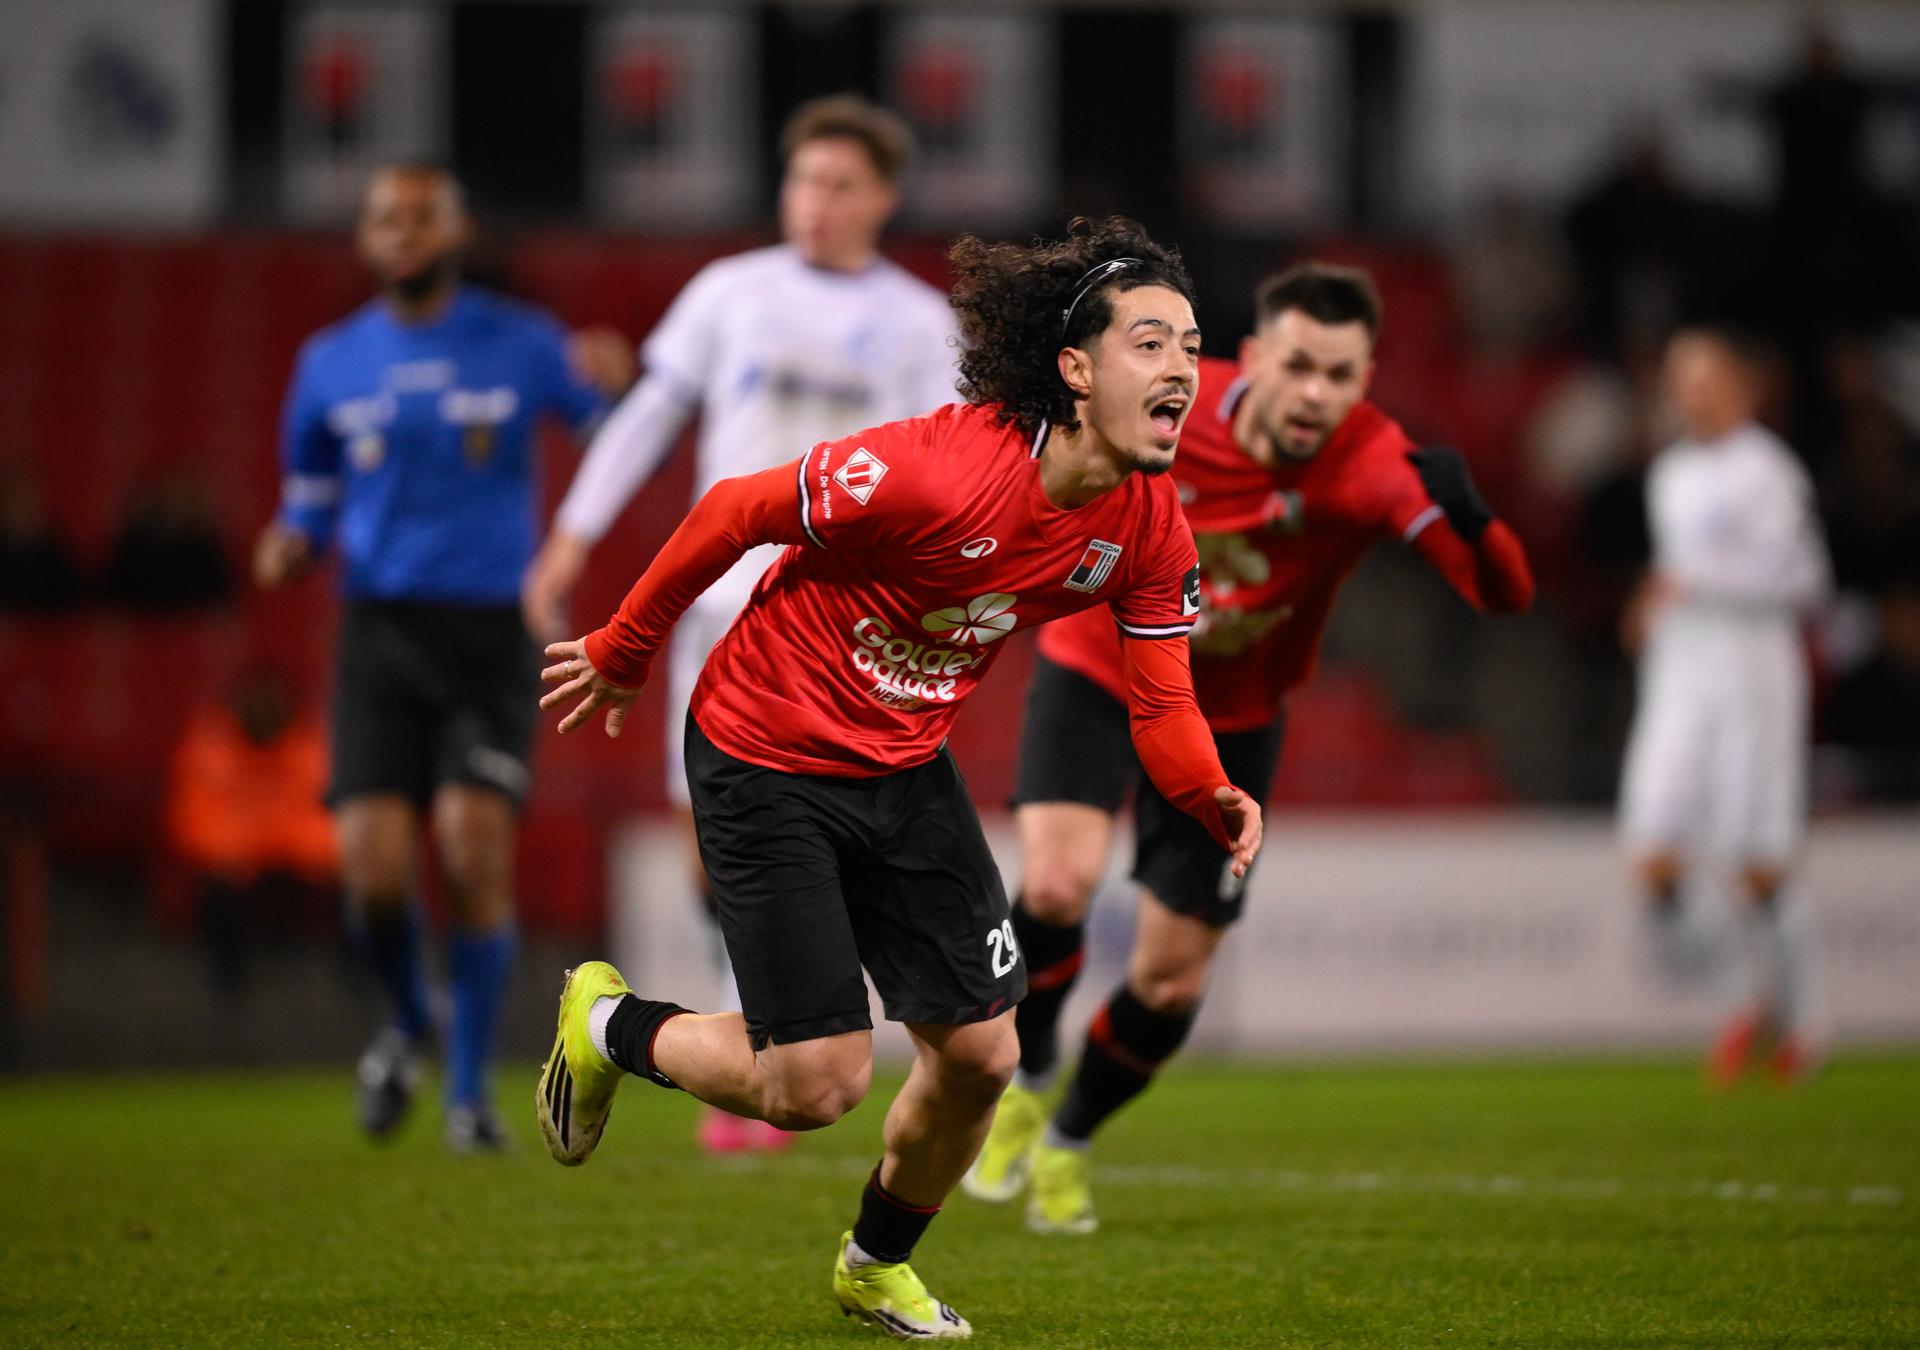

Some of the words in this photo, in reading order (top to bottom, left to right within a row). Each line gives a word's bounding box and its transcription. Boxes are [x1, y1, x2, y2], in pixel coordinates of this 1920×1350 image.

[820, 476, 829, 488] De
[1091, 541, 1120, 553] RWDM
[852, 616, 988, 676] Golde
[986, 919, 1018, 979] 29
